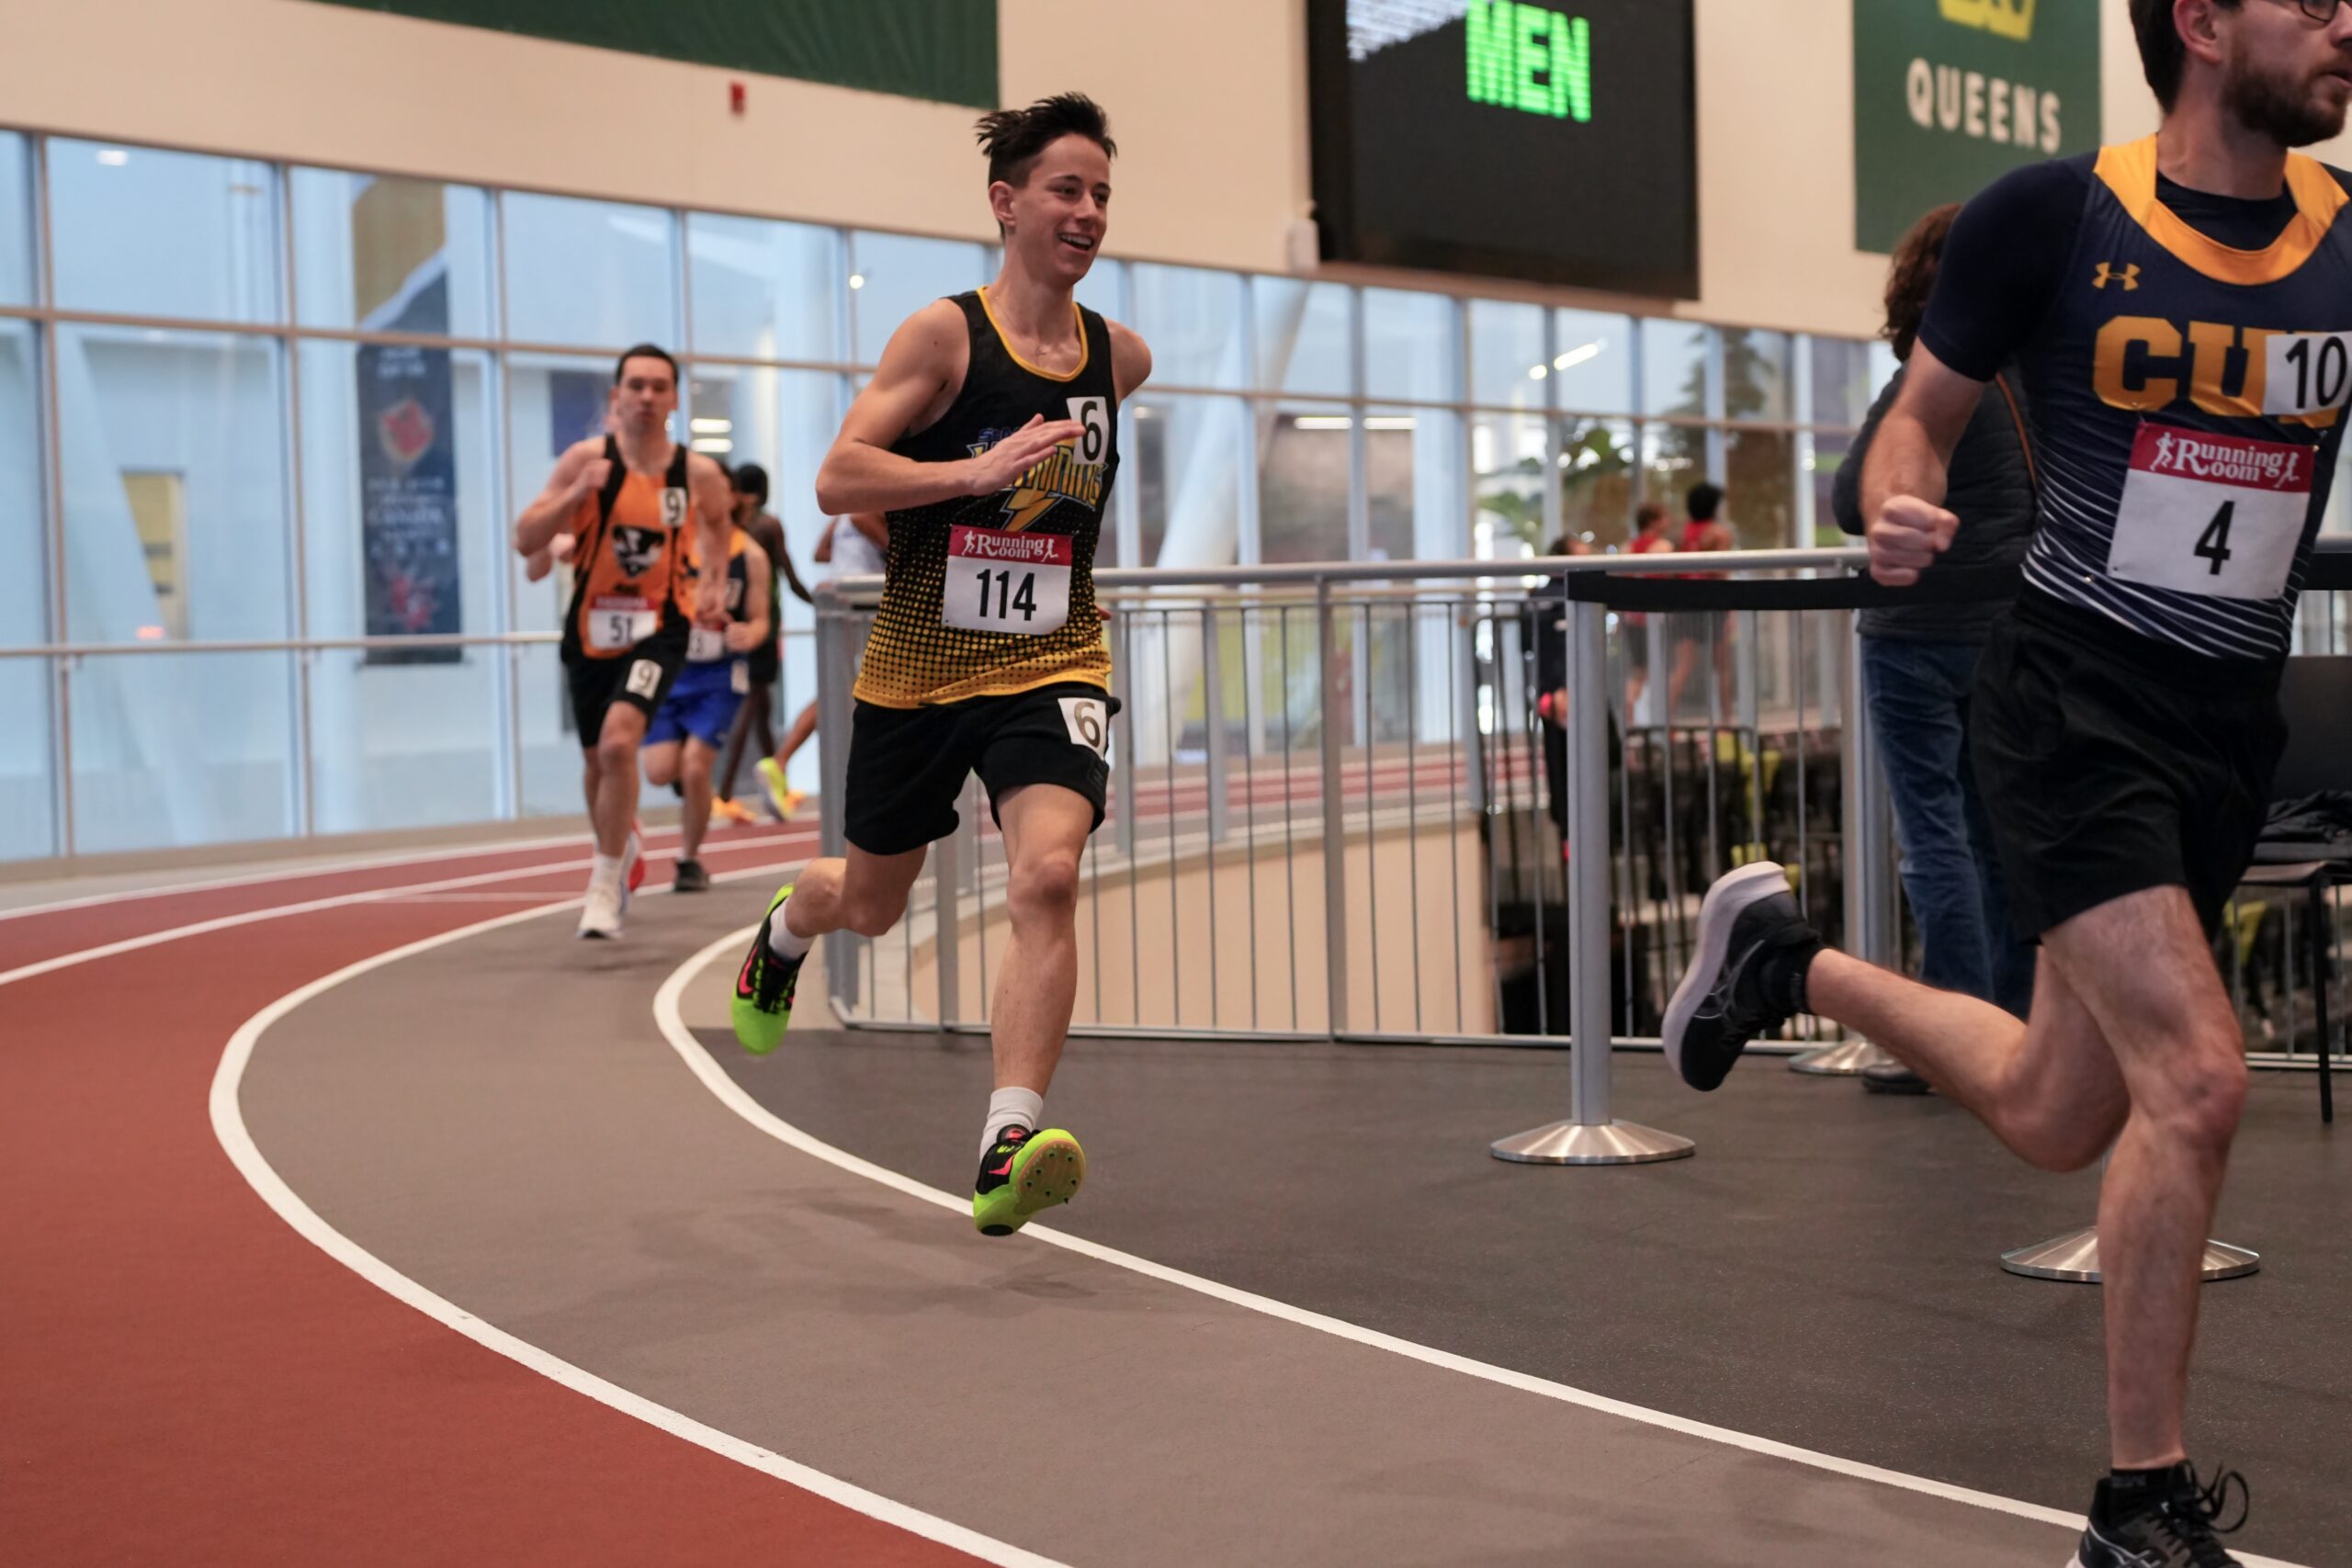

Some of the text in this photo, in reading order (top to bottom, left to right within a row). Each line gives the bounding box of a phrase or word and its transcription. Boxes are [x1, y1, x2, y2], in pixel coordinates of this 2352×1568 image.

[1465, 0, 1590, 123] MEN
[1906, 57, 2061, 154] QUEENS
[2093, 315, 2340, 429] CU
[2285, 336, 2347, 410] 10
[1080, 400, 1102, 461] 6
[2174, 438, 2286, 478] Running
[665, 489, 681, 525] 9
[975, 534, 1045, 557] Running
[2194, 501, 2235, 576] 4
[977, 569, 1037, 621] 114
[638, 663, 652, 687] 9
[1074, 701, 1101, 749] 6
